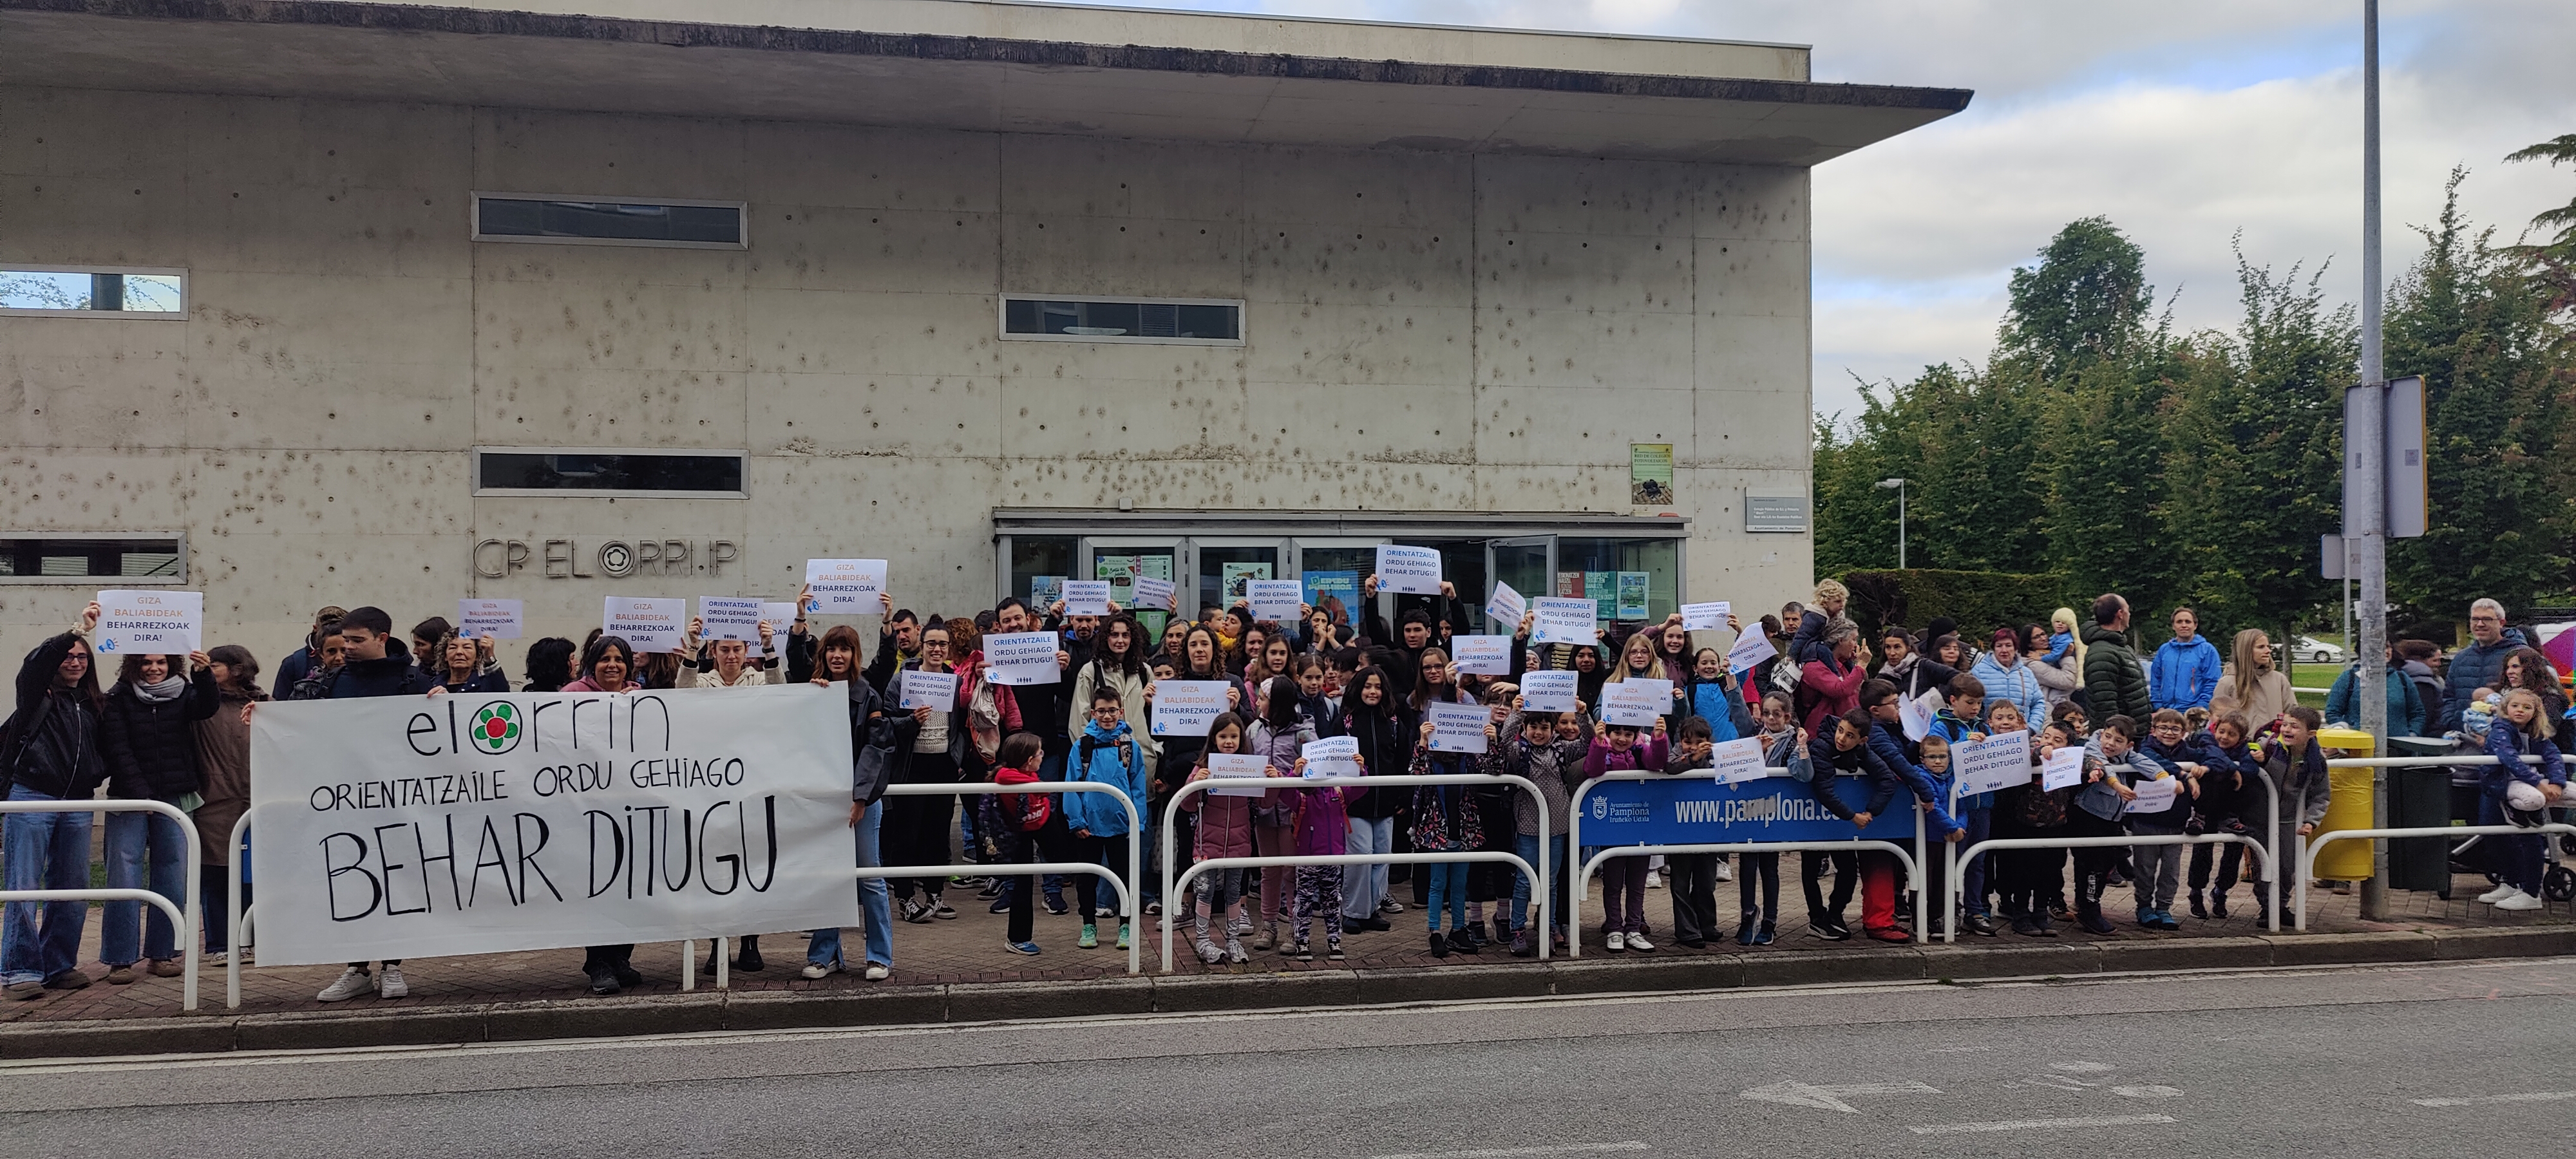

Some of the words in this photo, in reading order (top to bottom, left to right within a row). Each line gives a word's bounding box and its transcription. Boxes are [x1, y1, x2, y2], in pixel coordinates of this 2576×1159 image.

[1387, 550, 1435, 558] ORIENTATZAILE
[114, 608, 184, 617] BALIABIDEAK
[107, 621, 190, 630] BEHARREZKOAK
[994, 636, 1052, 646] ORIENTATZAILE
[1018, 646, 1052, 655] GEHIAGO
[1022, 656, 1054, 664] DITUGU!
[909, 674, 952, 683] ORIENTATZAILE
[1437, 713, 1483, 721] ORIENTATZAILE
[1310, 740, 1354, 750] ORIENTATZAILE
[1962, 736, 2022, 754] ORIENTATZAILE
[1964, 755, 1985, 764] ORDU
[1987, 747, 2023, 759] GEHIAGO
[1965, 764, 1989, 775] BEHAR
[1991, 757, 2024, 769] DITUGU!
[533, 760, 614, 798] ORDU
[1609, 807, 1650, 818] Pamplona
[318, 811, 564, 923] BEHAR
